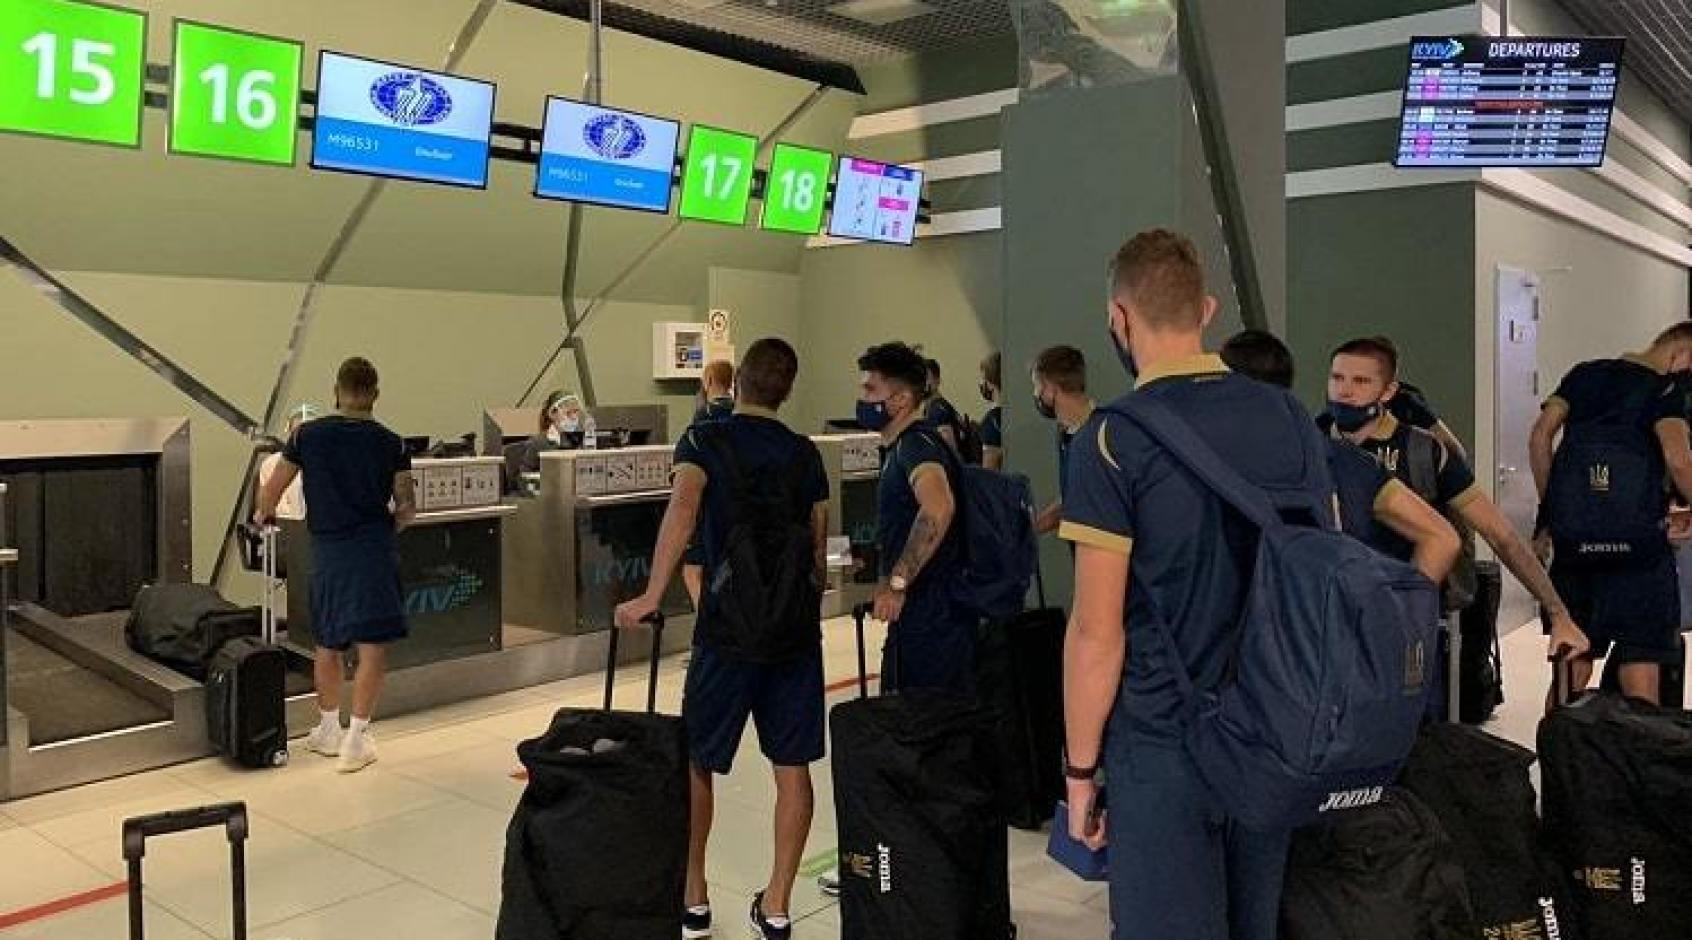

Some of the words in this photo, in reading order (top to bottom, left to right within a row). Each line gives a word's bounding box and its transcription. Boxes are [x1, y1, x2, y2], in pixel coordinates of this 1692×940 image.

[20, 31, 117, 105] 15
[1488, 42, 1581, 58] DEPARTURES
[199, 62, 278, 131] 16
[700, 152, 742, 200] 17
[778, 169, 817, 213] 18
[402, 582, 453, 616] YIV
[1538, 897, 1561, 940] Jom
